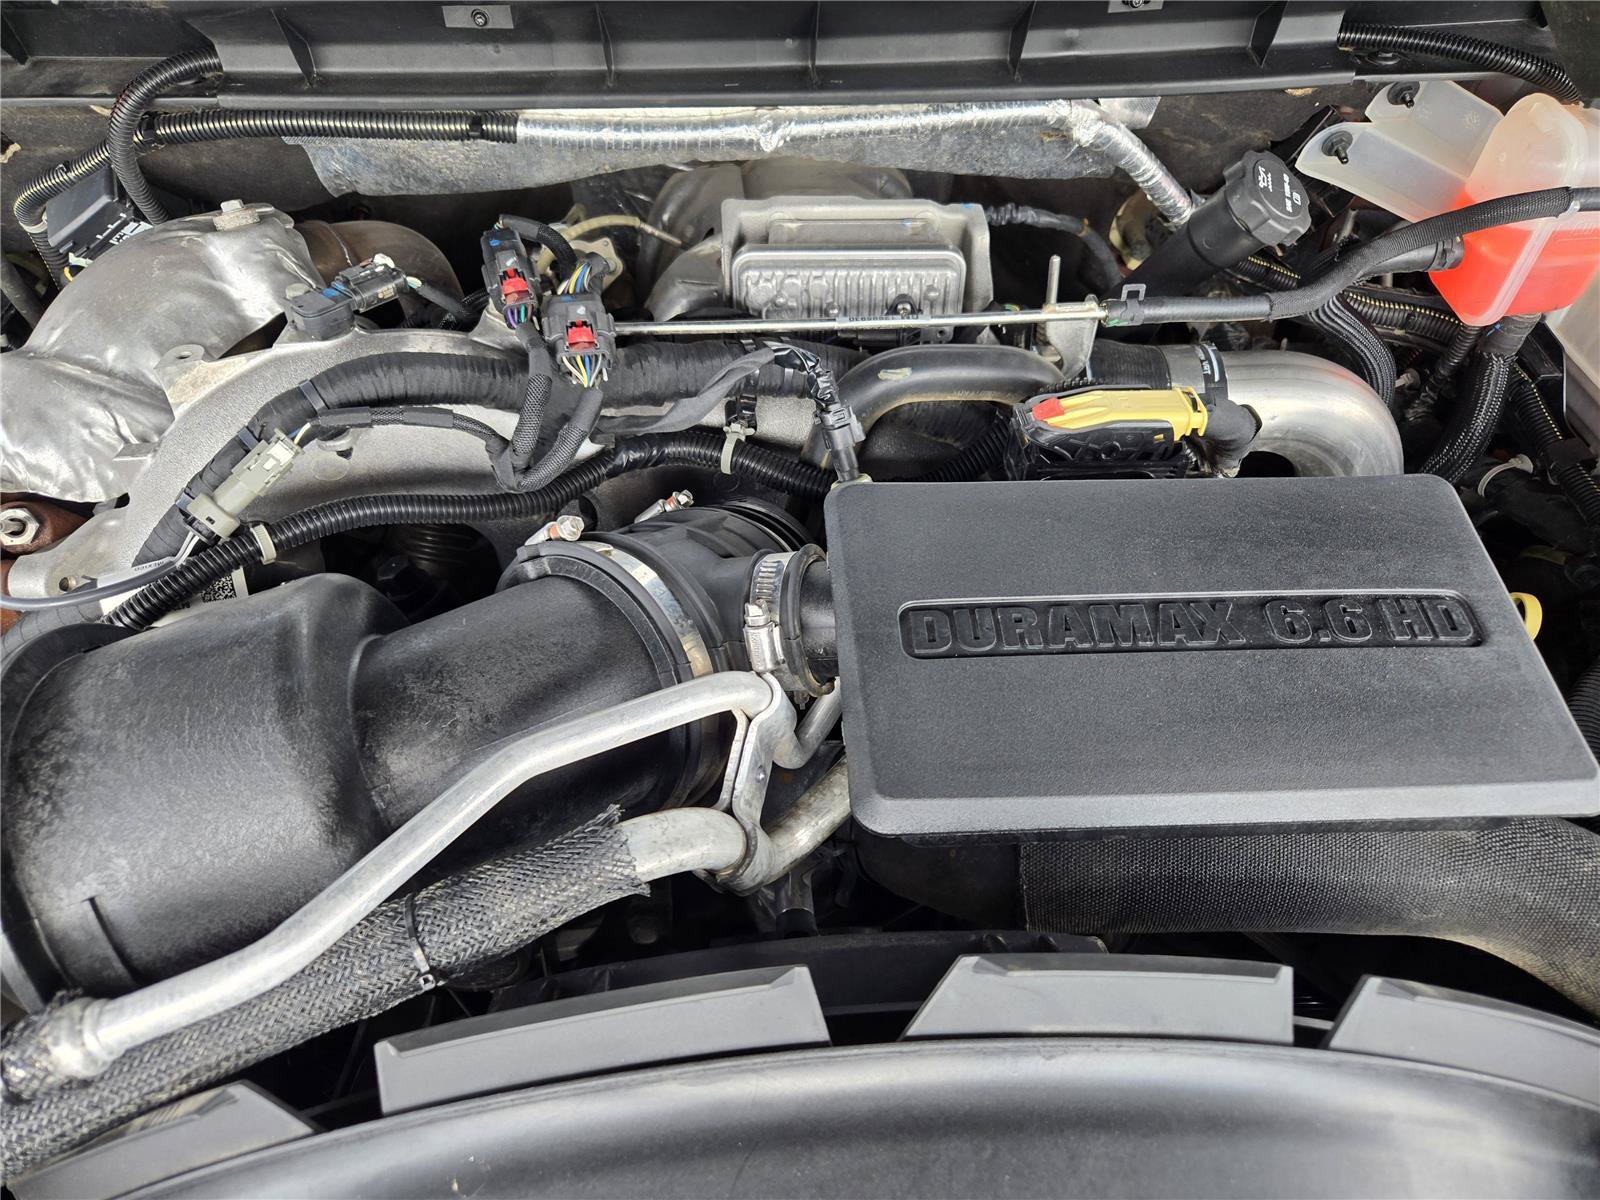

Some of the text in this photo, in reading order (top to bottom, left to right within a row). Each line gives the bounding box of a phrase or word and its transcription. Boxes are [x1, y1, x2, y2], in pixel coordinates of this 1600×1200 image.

[909, 599, 1474, 654] DURAMAX 6.6 HD
